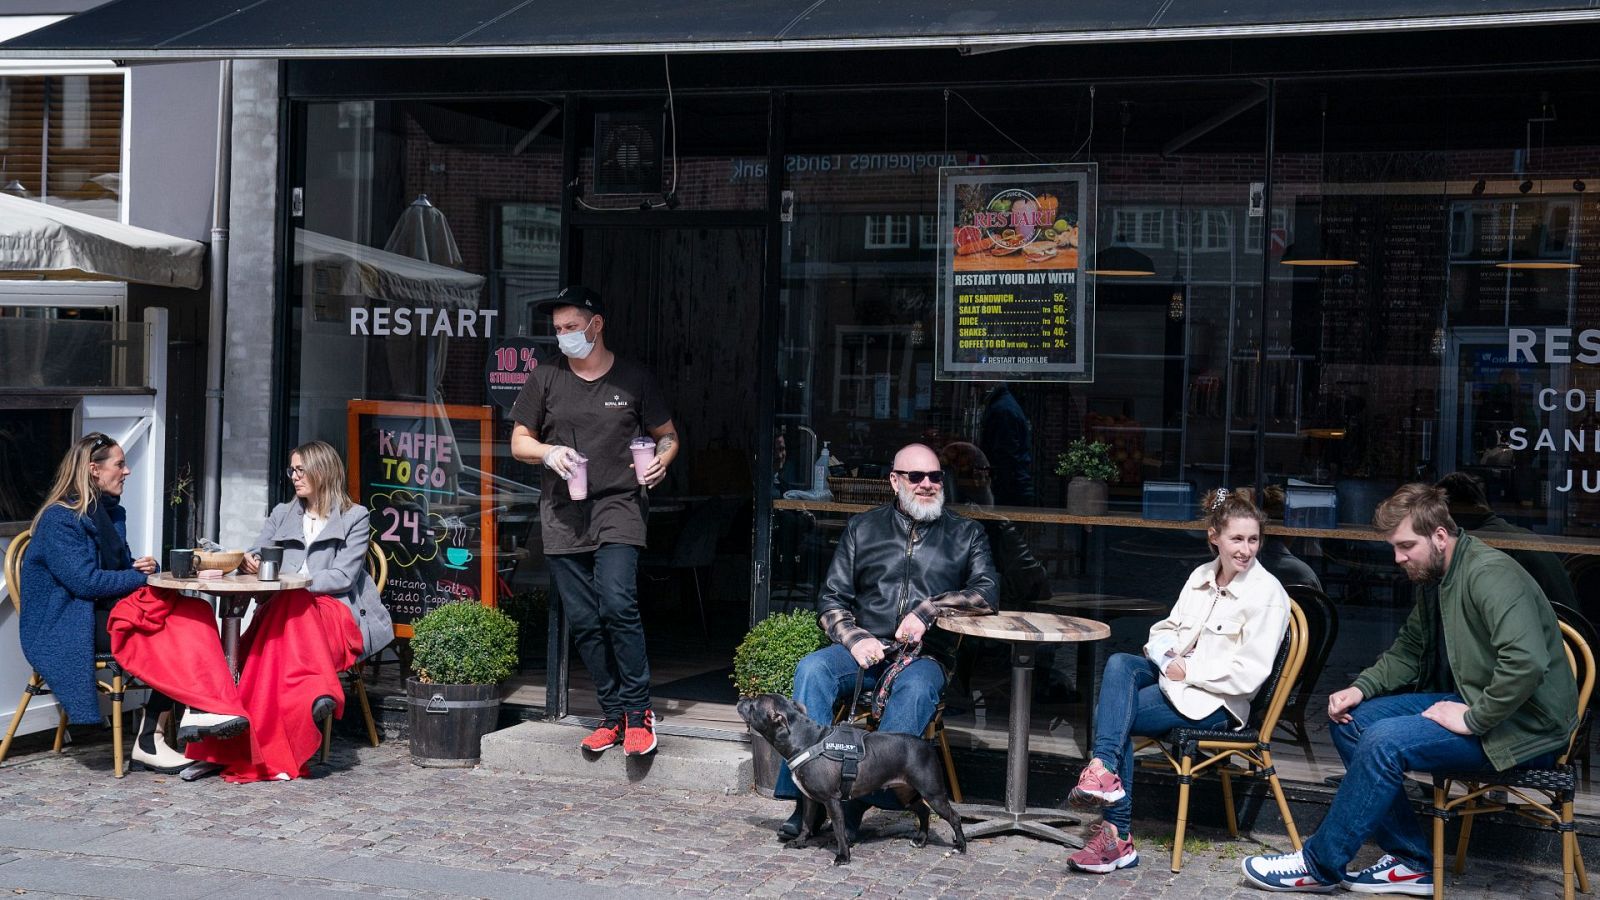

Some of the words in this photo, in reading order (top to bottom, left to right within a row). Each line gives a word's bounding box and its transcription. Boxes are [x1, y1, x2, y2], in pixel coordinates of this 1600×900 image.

[973, 208, 1056, 228] RESTART
[955, 274, 997, 286] RESTART
[999, 273, 1025, 285] YOUR
[1027, 272, 1046, 284] DAY
[1047, 272, 1075, 284] WITH
[959, 295, 973, 303] HOT
[974, 294, 1014, 303] SANDWICH
[959, 306, 980, 314] SALAT
[981, 305, 1003, 314] BOWL
[350, 307, 498, 338] RESTART
[959, 317, 978, 326] JUICE
[959, 328, 987, 337] SHAKES
[959, 340, 983, 349] COFFEE
[984, 340, 994, 348] TO
[995, 339, 1006, 348] GO
[1508, 328, 1600, 364] RES
[495, 347, 518, 372] 10
[520, 347, 538, 372] %
[1017, 356, 1048, 364] ROSKILDE
[1538, 388, 1600, 412] CO
[378, 429, 453, 463] KAFFE
[1508, 427, 1600, 452] SAN
[382, 458, 411, 485] TO
[414, 463, 446, 488] GO
[1555, 469, 1600, 493] JU
[380, 506, 435, 546] 24,-
[386, 578, 427, 590] ericano
[436, 580, 468, 596] Latte
